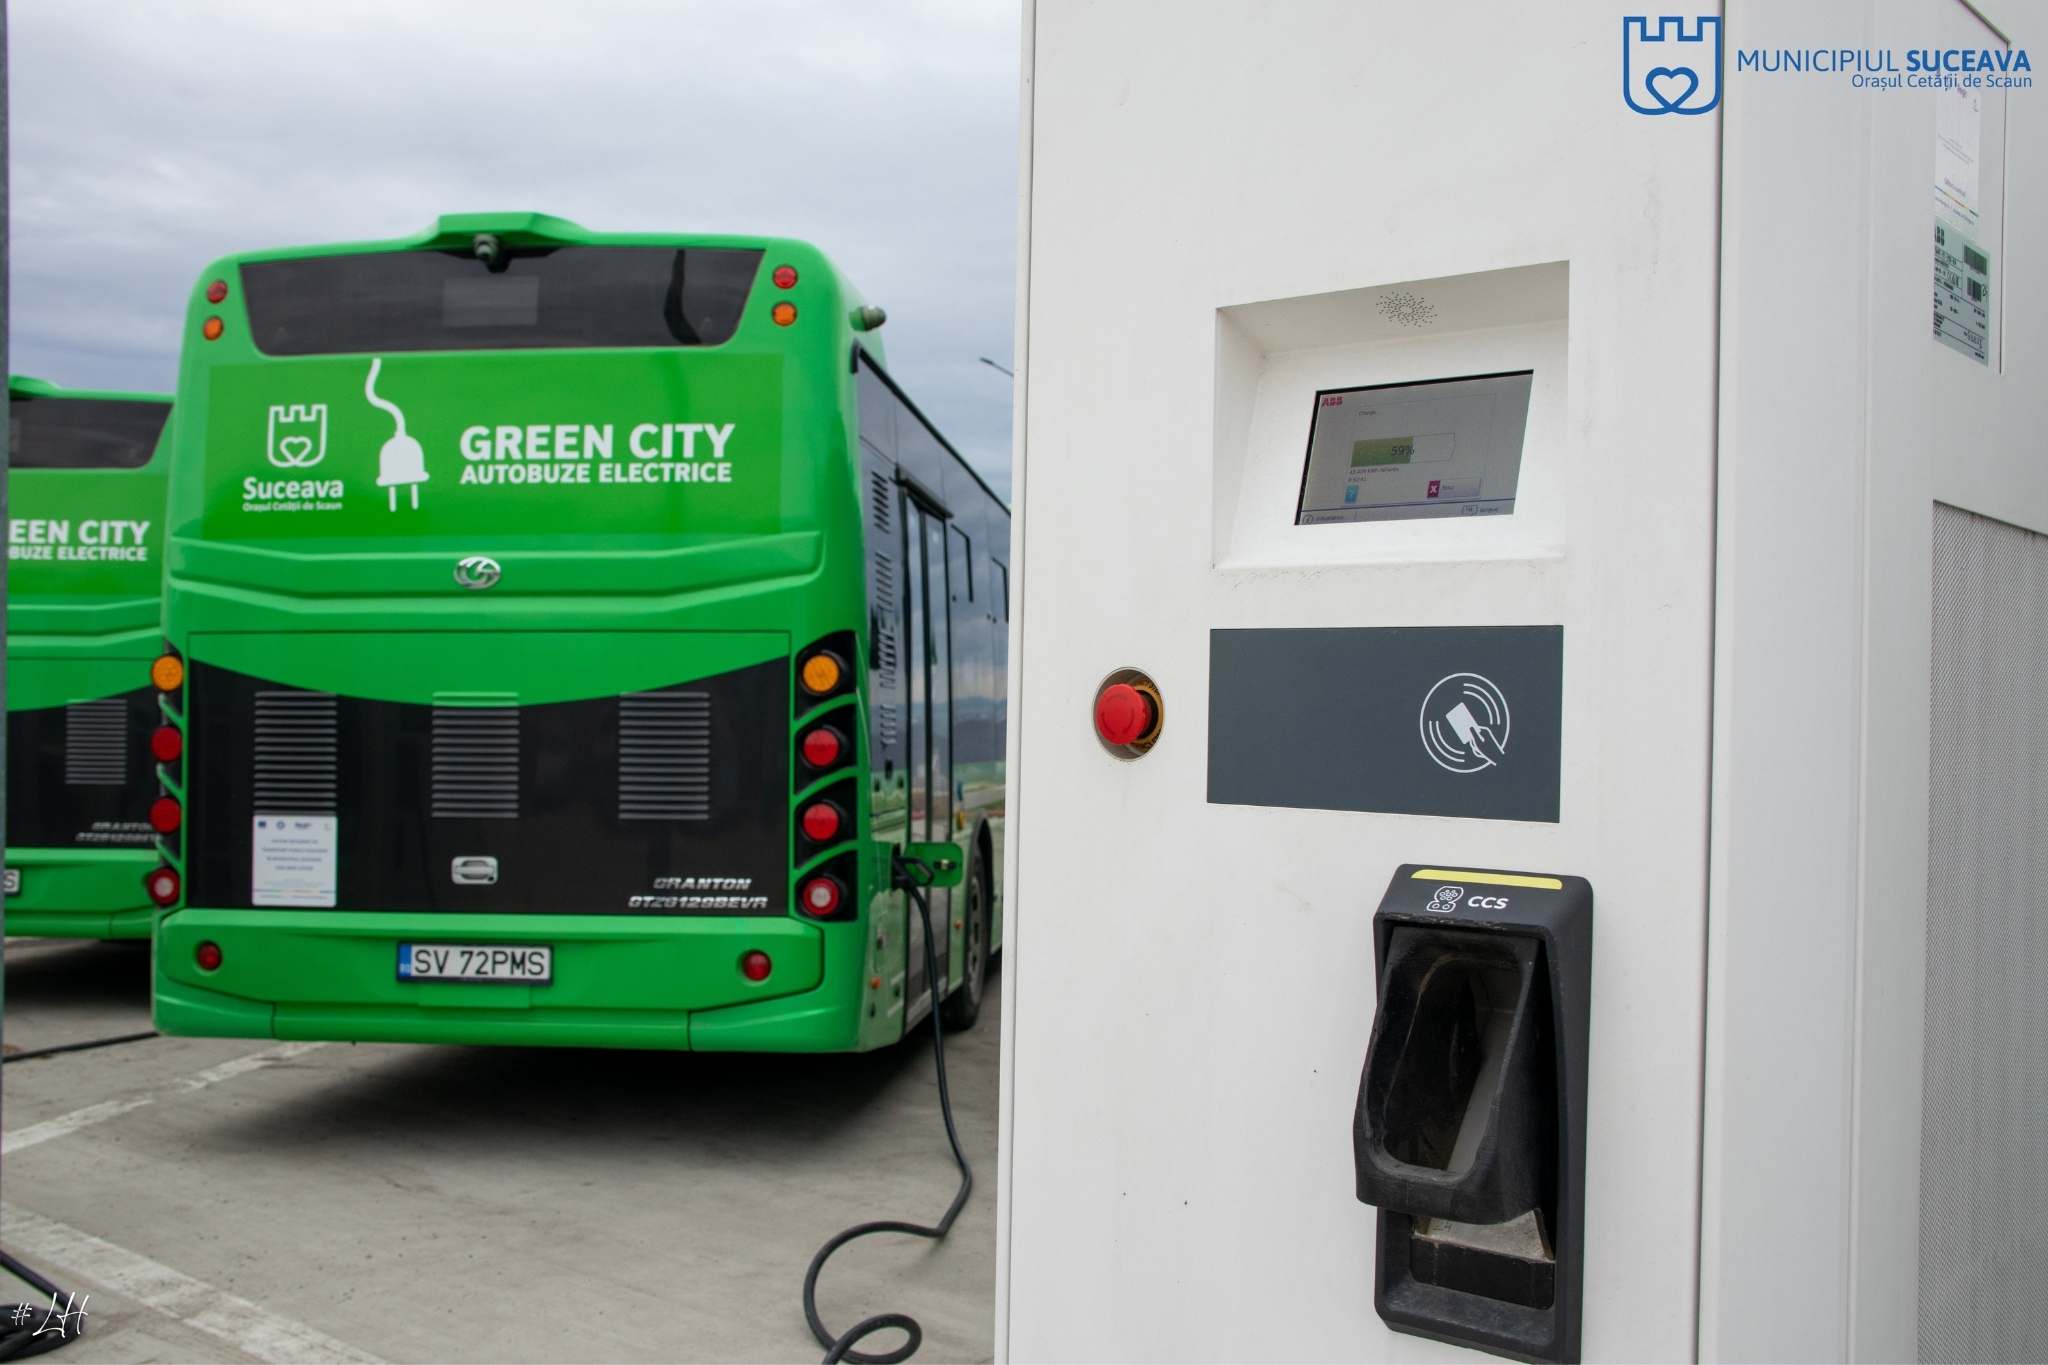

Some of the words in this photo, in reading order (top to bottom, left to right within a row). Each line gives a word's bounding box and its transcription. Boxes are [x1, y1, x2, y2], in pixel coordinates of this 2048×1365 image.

[1321, 396, 1343, 407] ABB
[460, 424, 613, 461] GREEN
[629, 423, 736, 459] CITY
[460, 463, 591, 484] AUTOBUZE
[599, 462, 732, 483] ELECTRICE
[243, 477, 344, 500] Suceava
[78, 520, 150, 545] CITY
[57, 546, 147, 561] ELECTRICE
[653, 877, 752, 890] GRANTON
[1467, 896, 1509, 909] CCS
[414, 949, 449, 974] SV
[460, 951, 545, 976] 72PMS
